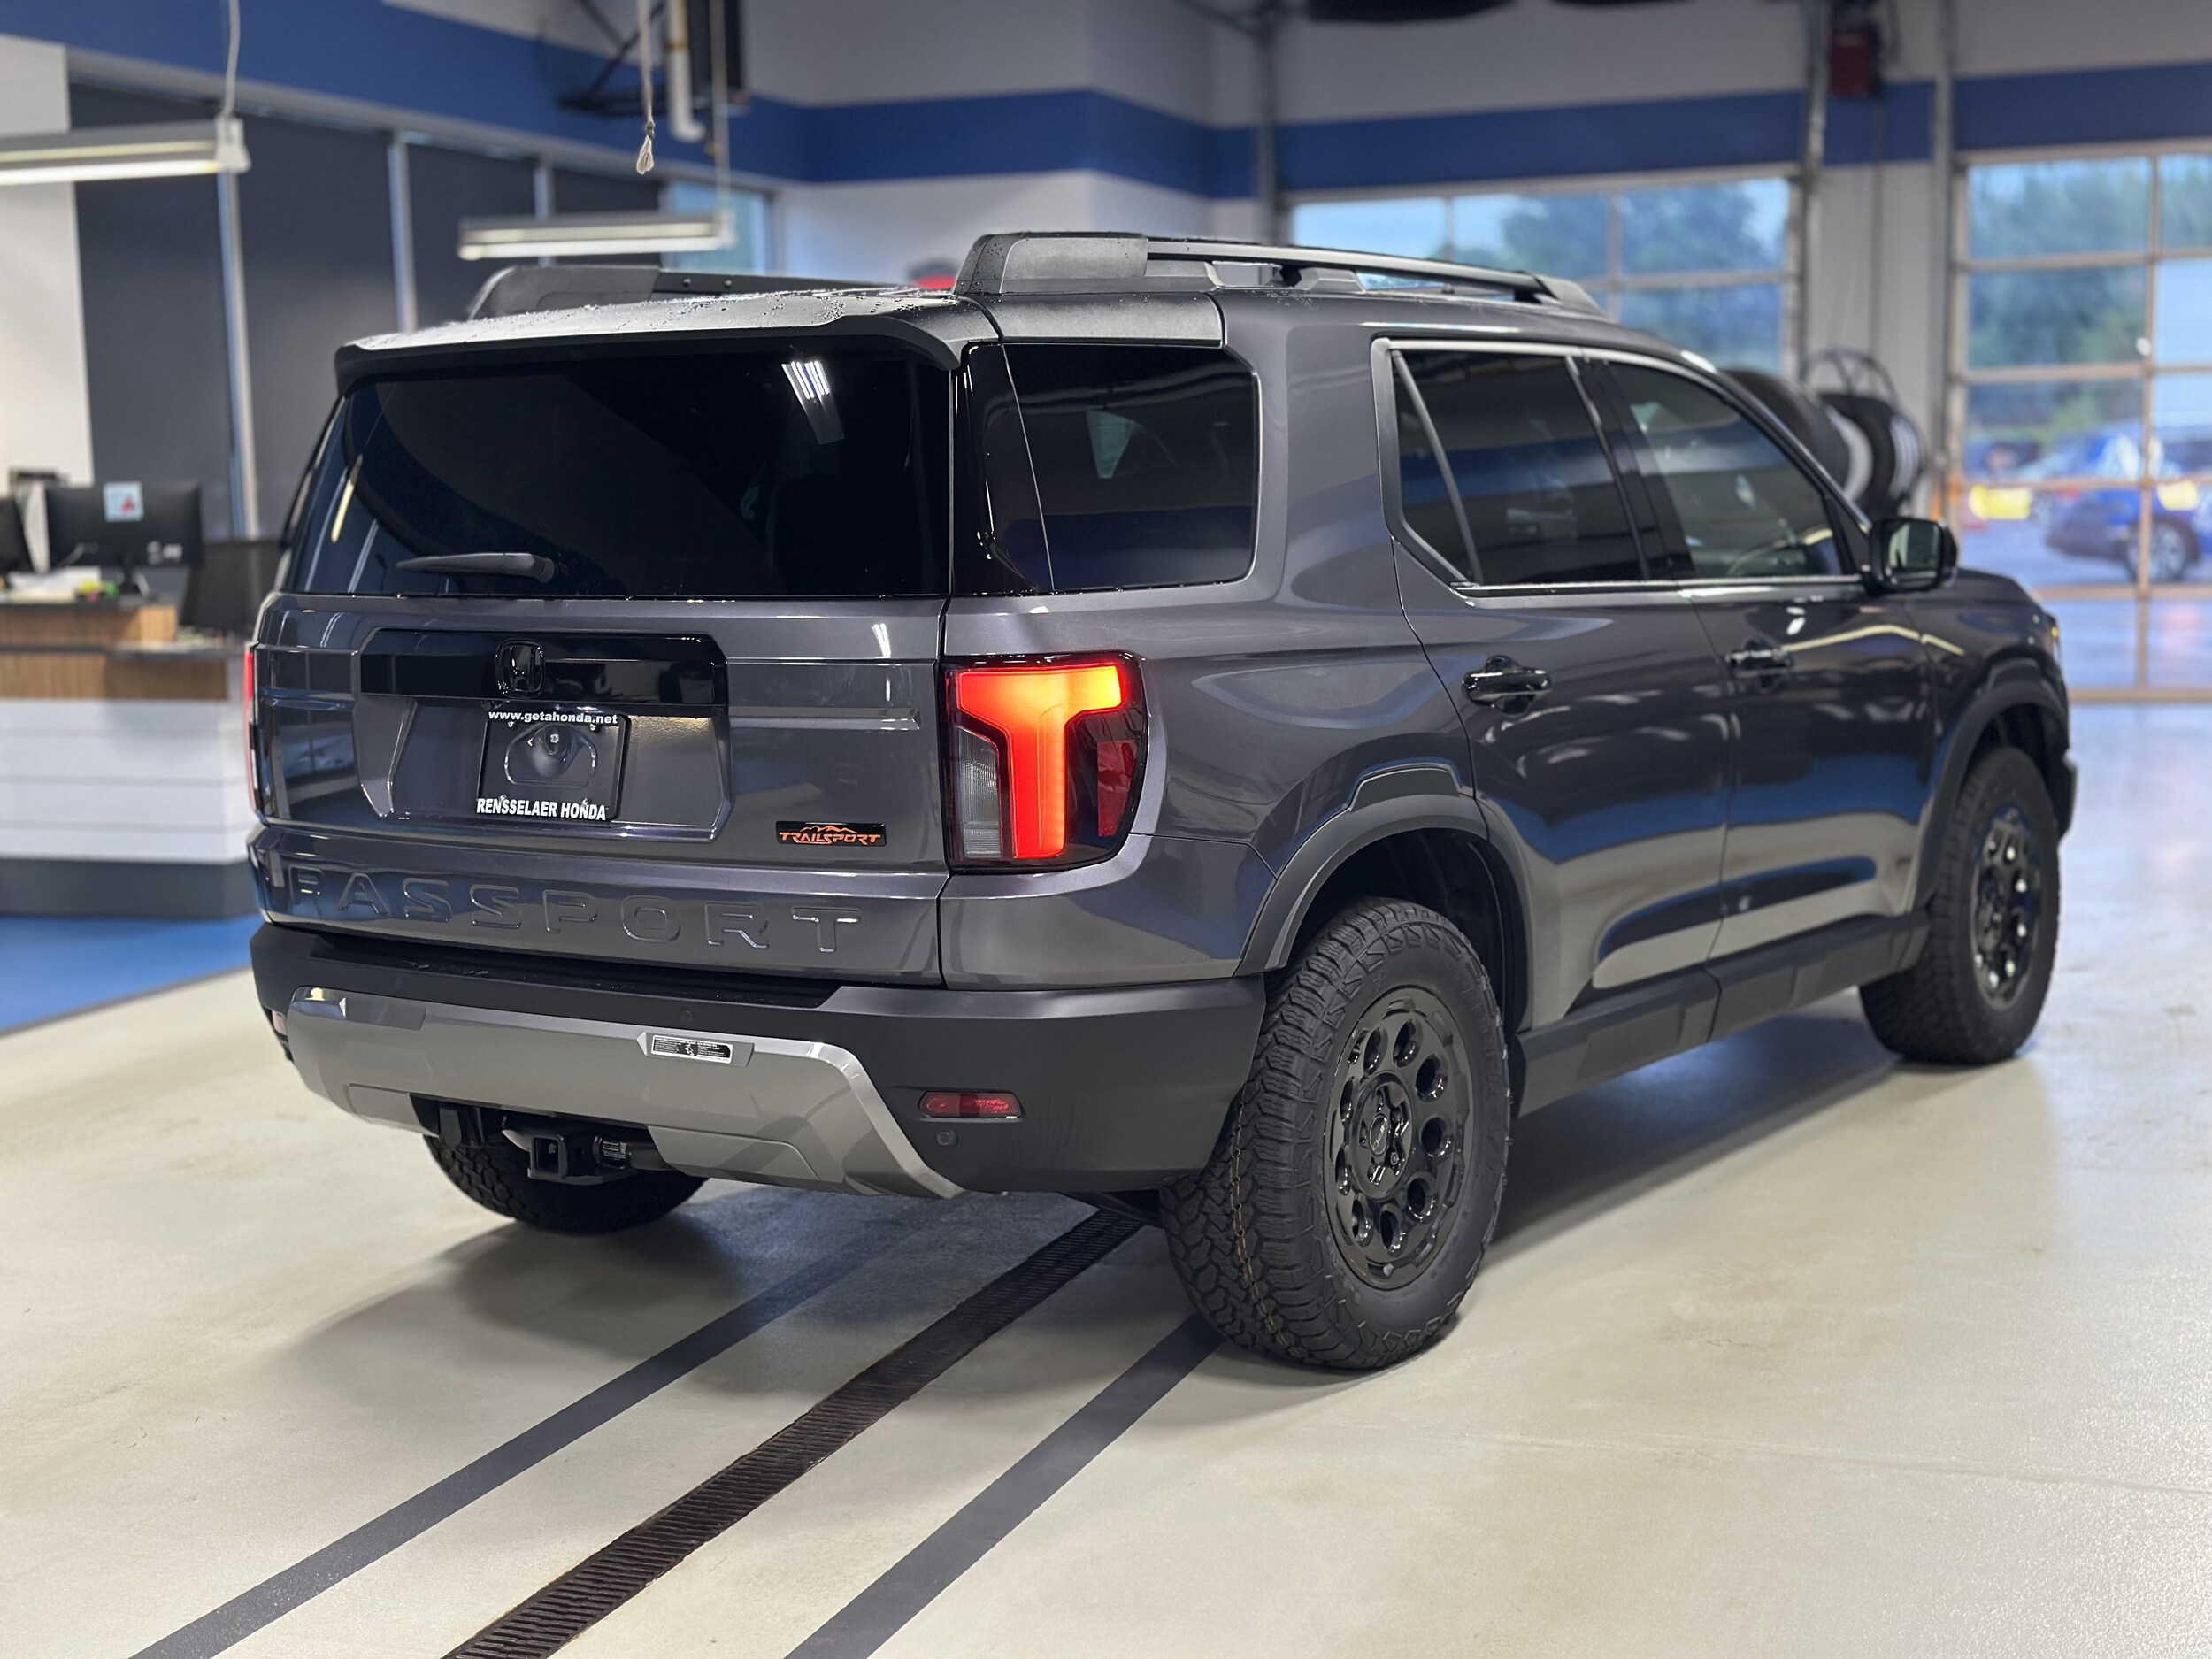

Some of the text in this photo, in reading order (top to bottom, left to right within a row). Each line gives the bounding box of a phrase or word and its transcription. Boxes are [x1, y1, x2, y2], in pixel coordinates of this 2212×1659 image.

[488, 710, 618, 725] www.getahonda.net
[476, 798, 607, 821] RENSSELAER HONDA
[779, 832, 881, 846] TRAILSPORT
[288, 864, 862, 952] PASSPORT
